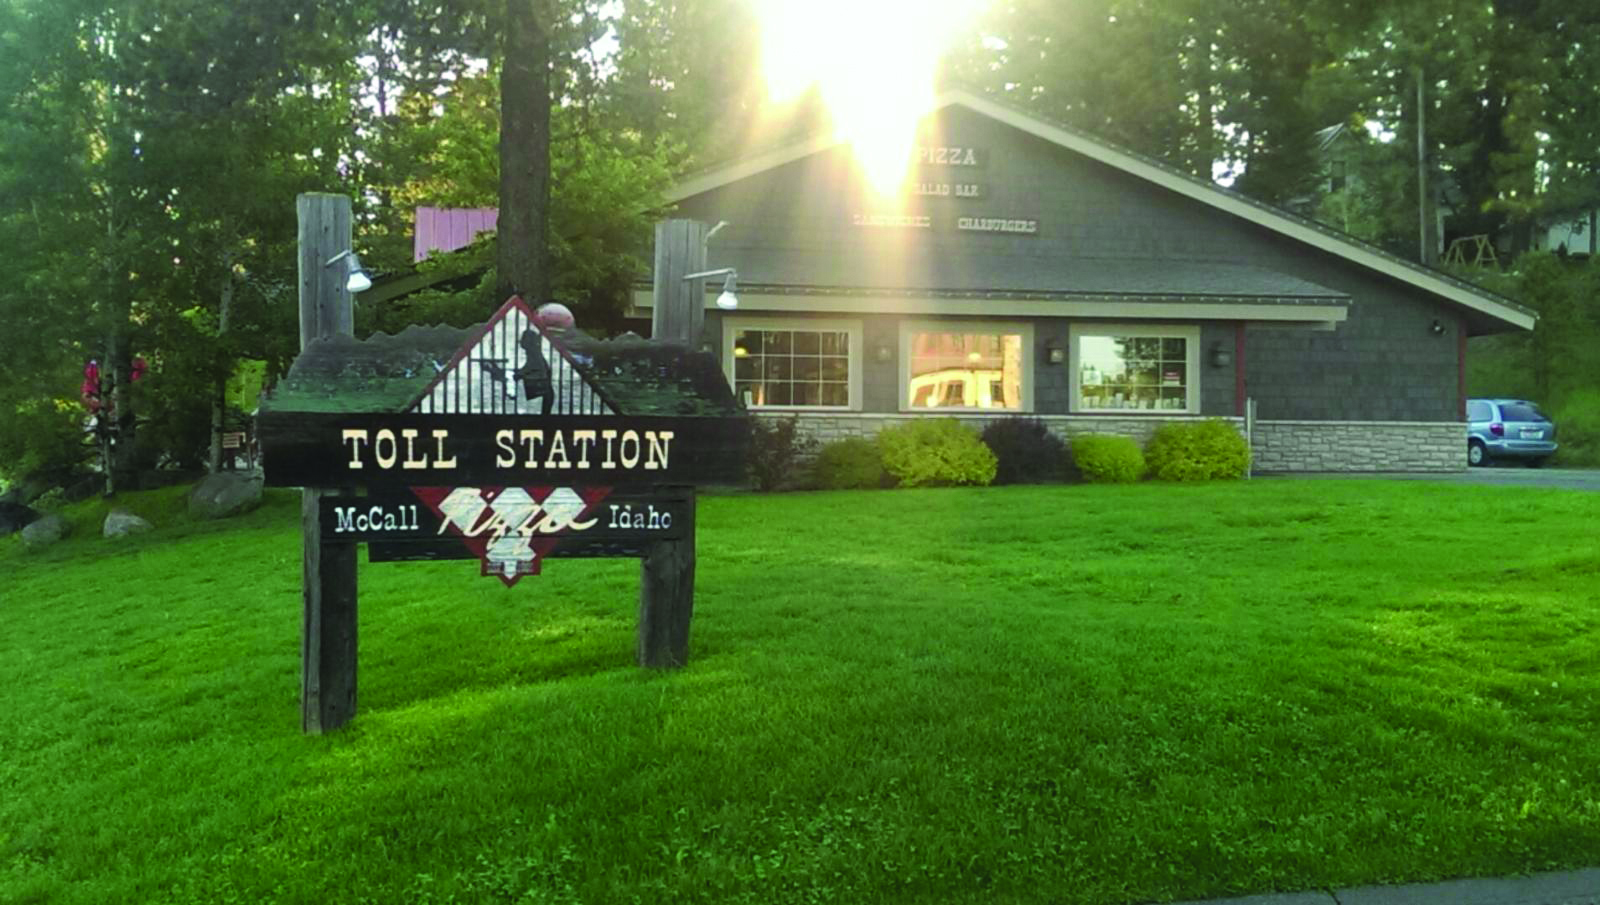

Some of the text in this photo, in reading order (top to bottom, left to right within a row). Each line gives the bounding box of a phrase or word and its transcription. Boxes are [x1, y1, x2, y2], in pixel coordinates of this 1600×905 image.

[918, 147, 977, 166] PIZZA
[913, 183, 979, 197] SALAD BAR
[957, 217, 1037, 233] CHARBURGERS
[342, 428, 675, 470] TOLL STATION
[334, 504, 420, 534] McCall
[608, 504, 673, 531] Idaho
